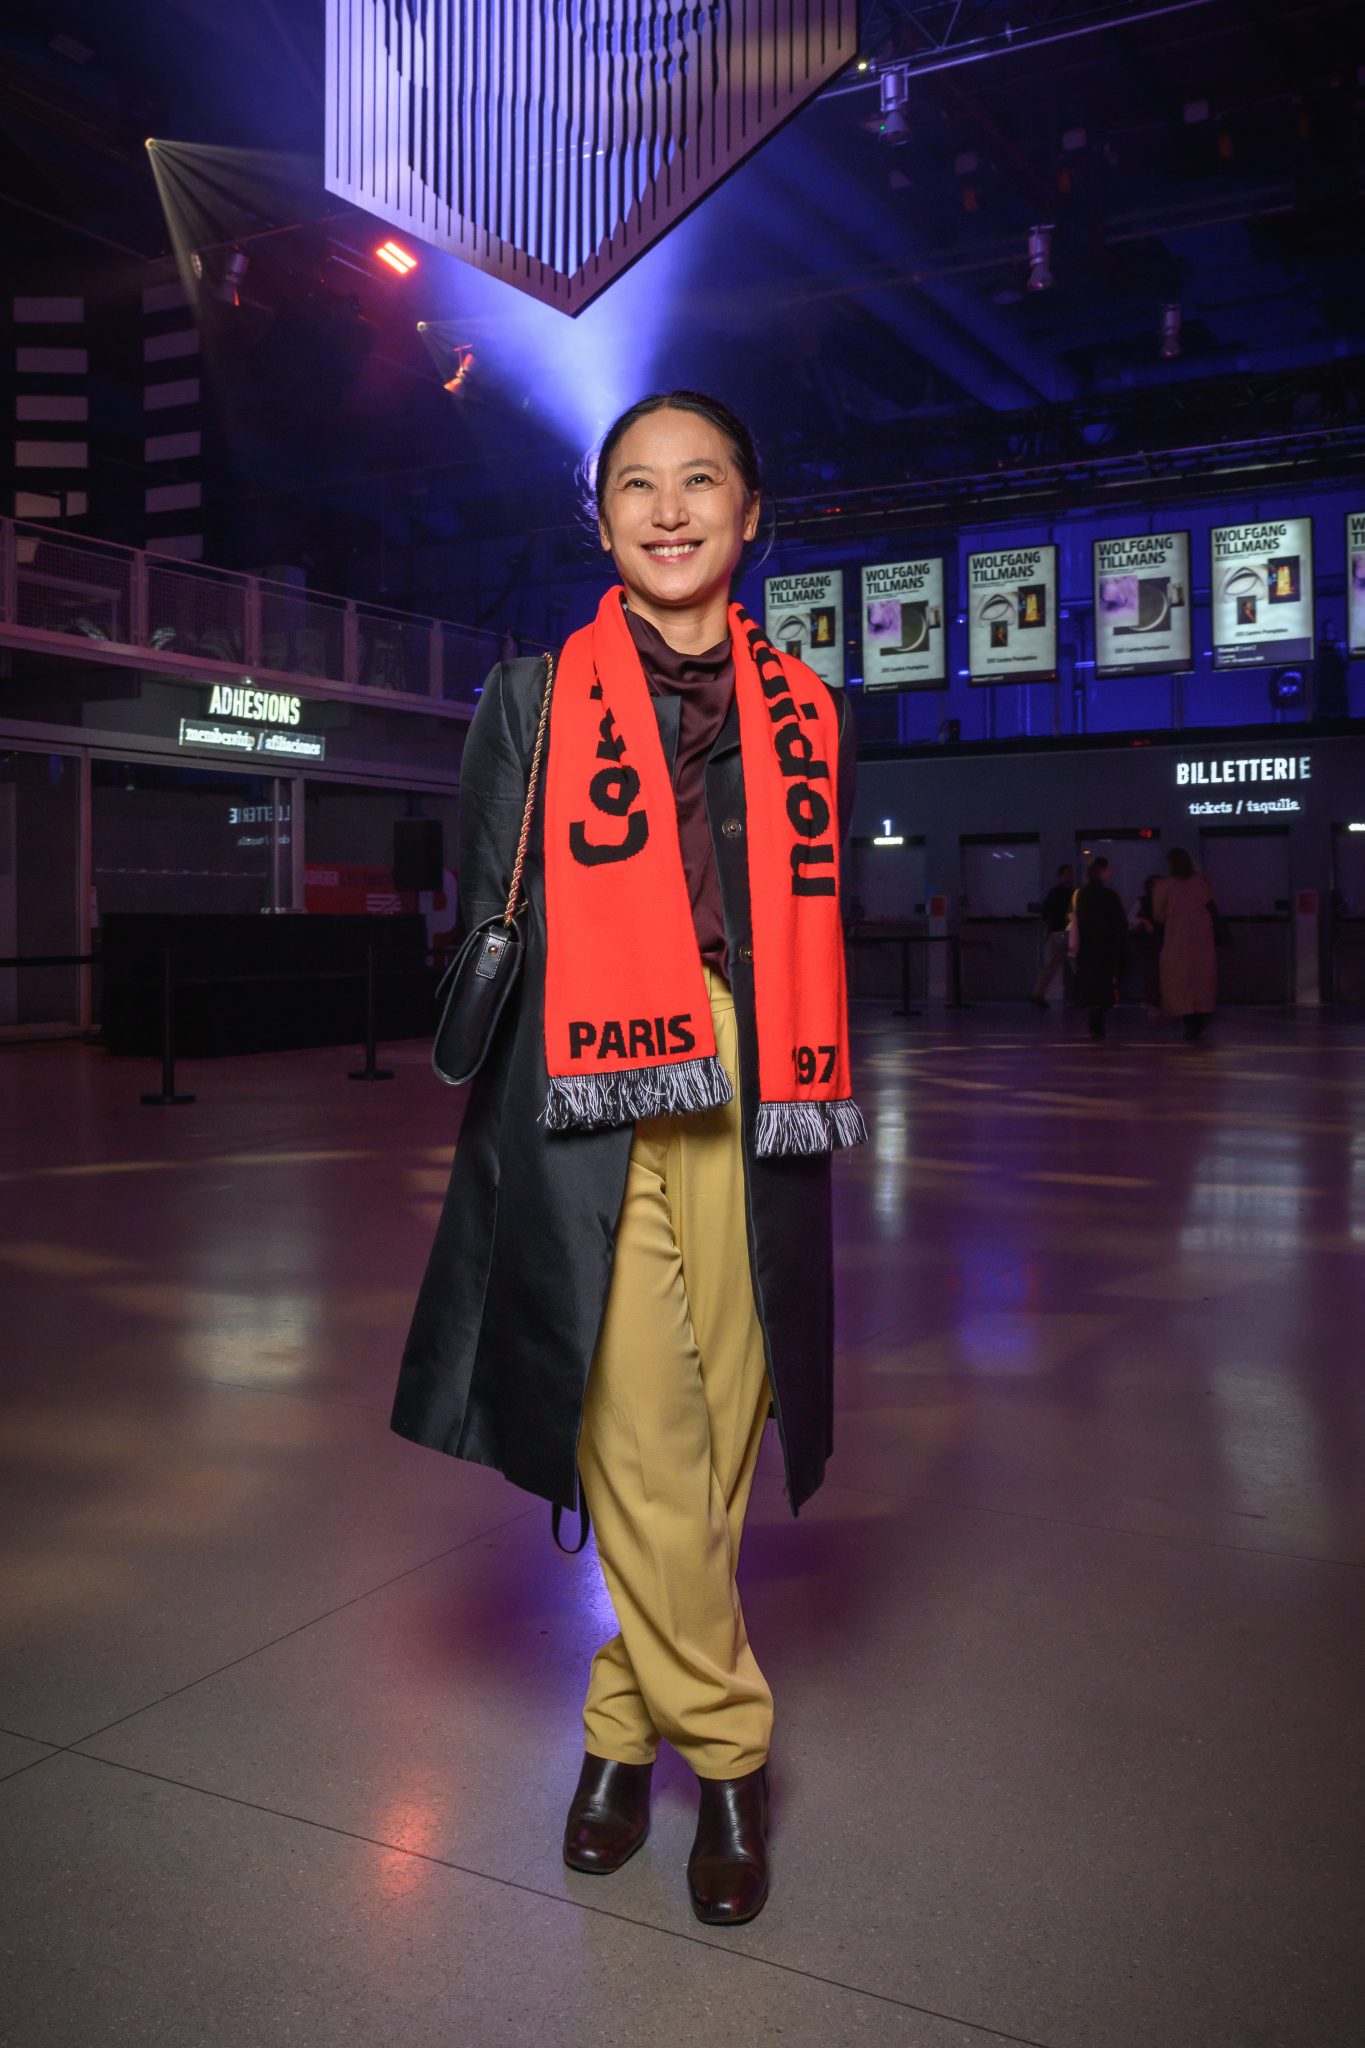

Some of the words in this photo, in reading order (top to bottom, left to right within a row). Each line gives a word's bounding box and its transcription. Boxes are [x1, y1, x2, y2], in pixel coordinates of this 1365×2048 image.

[1215, 524, 1287, 543] WOLFGANG
[1099, 537, 1174, 556] WOLFGANG
[1215, 537, 1280, 556] TILLMANS
[972, 551, 1041, 570] WOLFGANG
[1099, 551, 1167, 569] TILLMANS
[866, 563, 931, 582] WOLFGANG
[972, 565, 1035, 582] TILLMANS
[769, 575, 832, 592] WOLFGANG
[866, 576, 925, 594] TILLMANS
[769, 588, 826, 604] TILLMANS
[1176, 756, 1311, 785] BILLETTERIE
[1189, 802, 1233, 814] tickets
[882, 819, 891, 836] 1
[568, 1013, 696, 1059] PARIS
